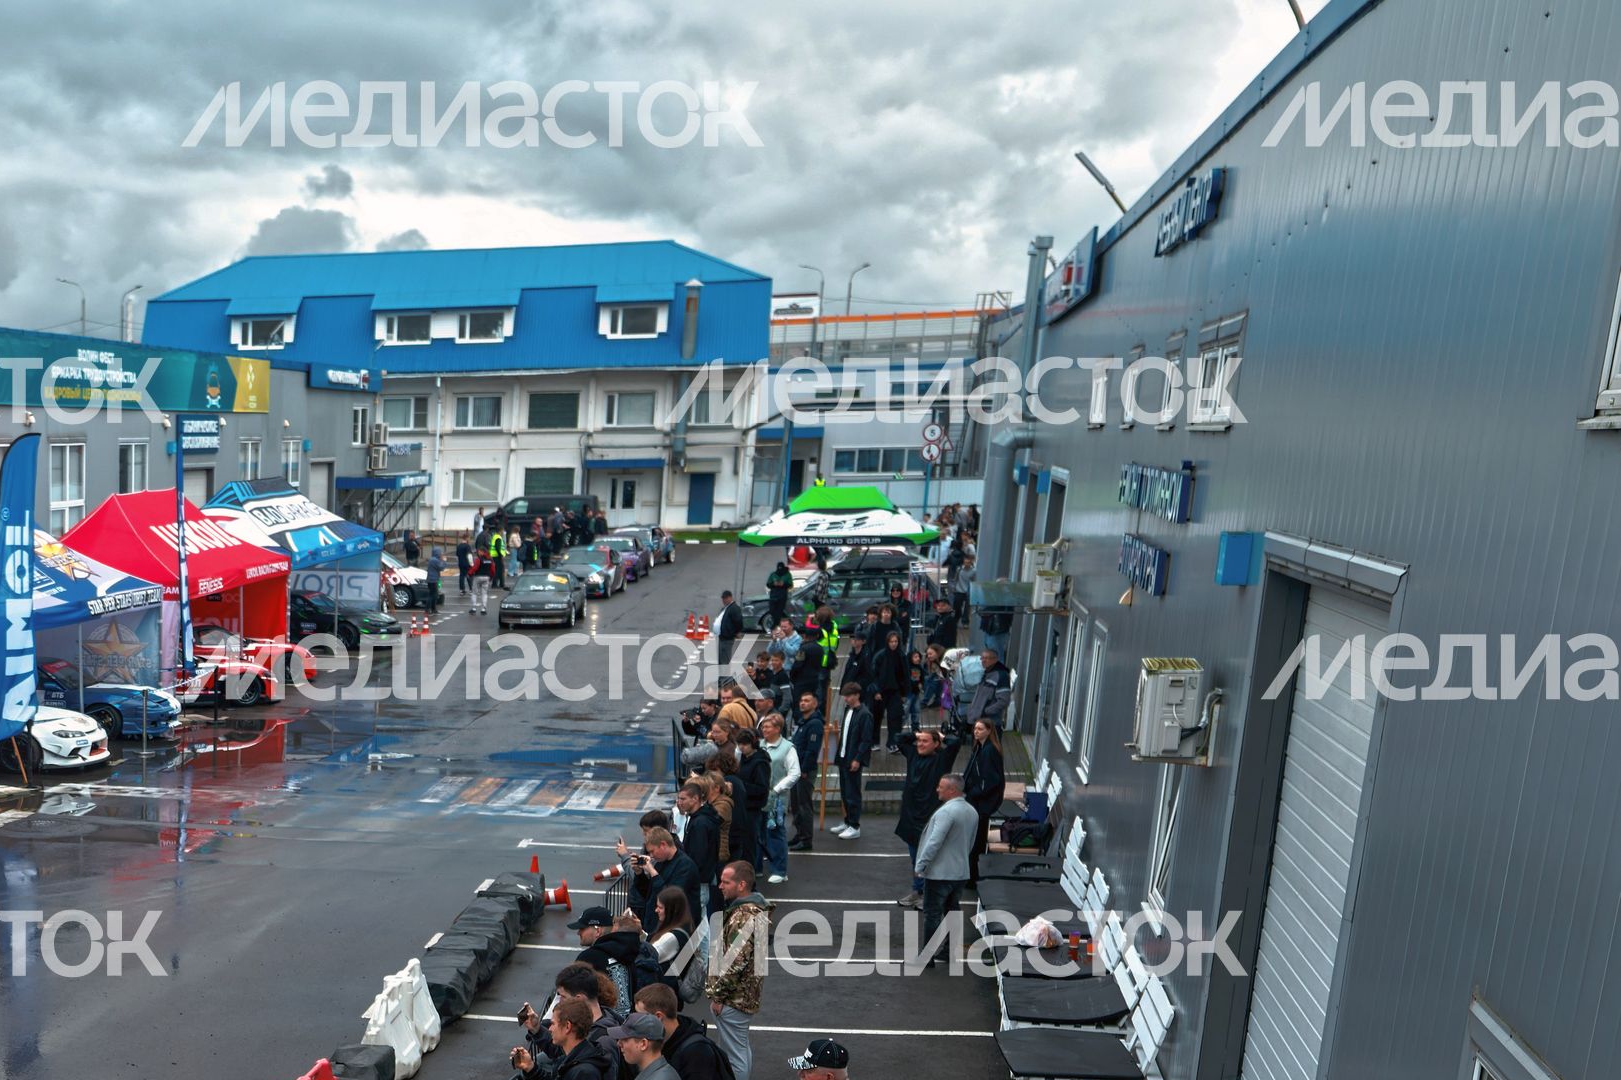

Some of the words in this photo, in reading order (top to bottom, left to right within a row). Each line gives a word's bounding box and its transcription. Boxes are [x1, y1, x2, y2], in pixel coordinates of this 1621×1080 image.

[99, 351, 115, 364] ФЕСТ
[796, 537, 844, 545] ALPHARD
[846, 537, 882, 545] GROUP
[163, 586, 179, 595] EAM
[87, 599, 105, 616] STAR
[2, 510, 36, 723] AIMOL
